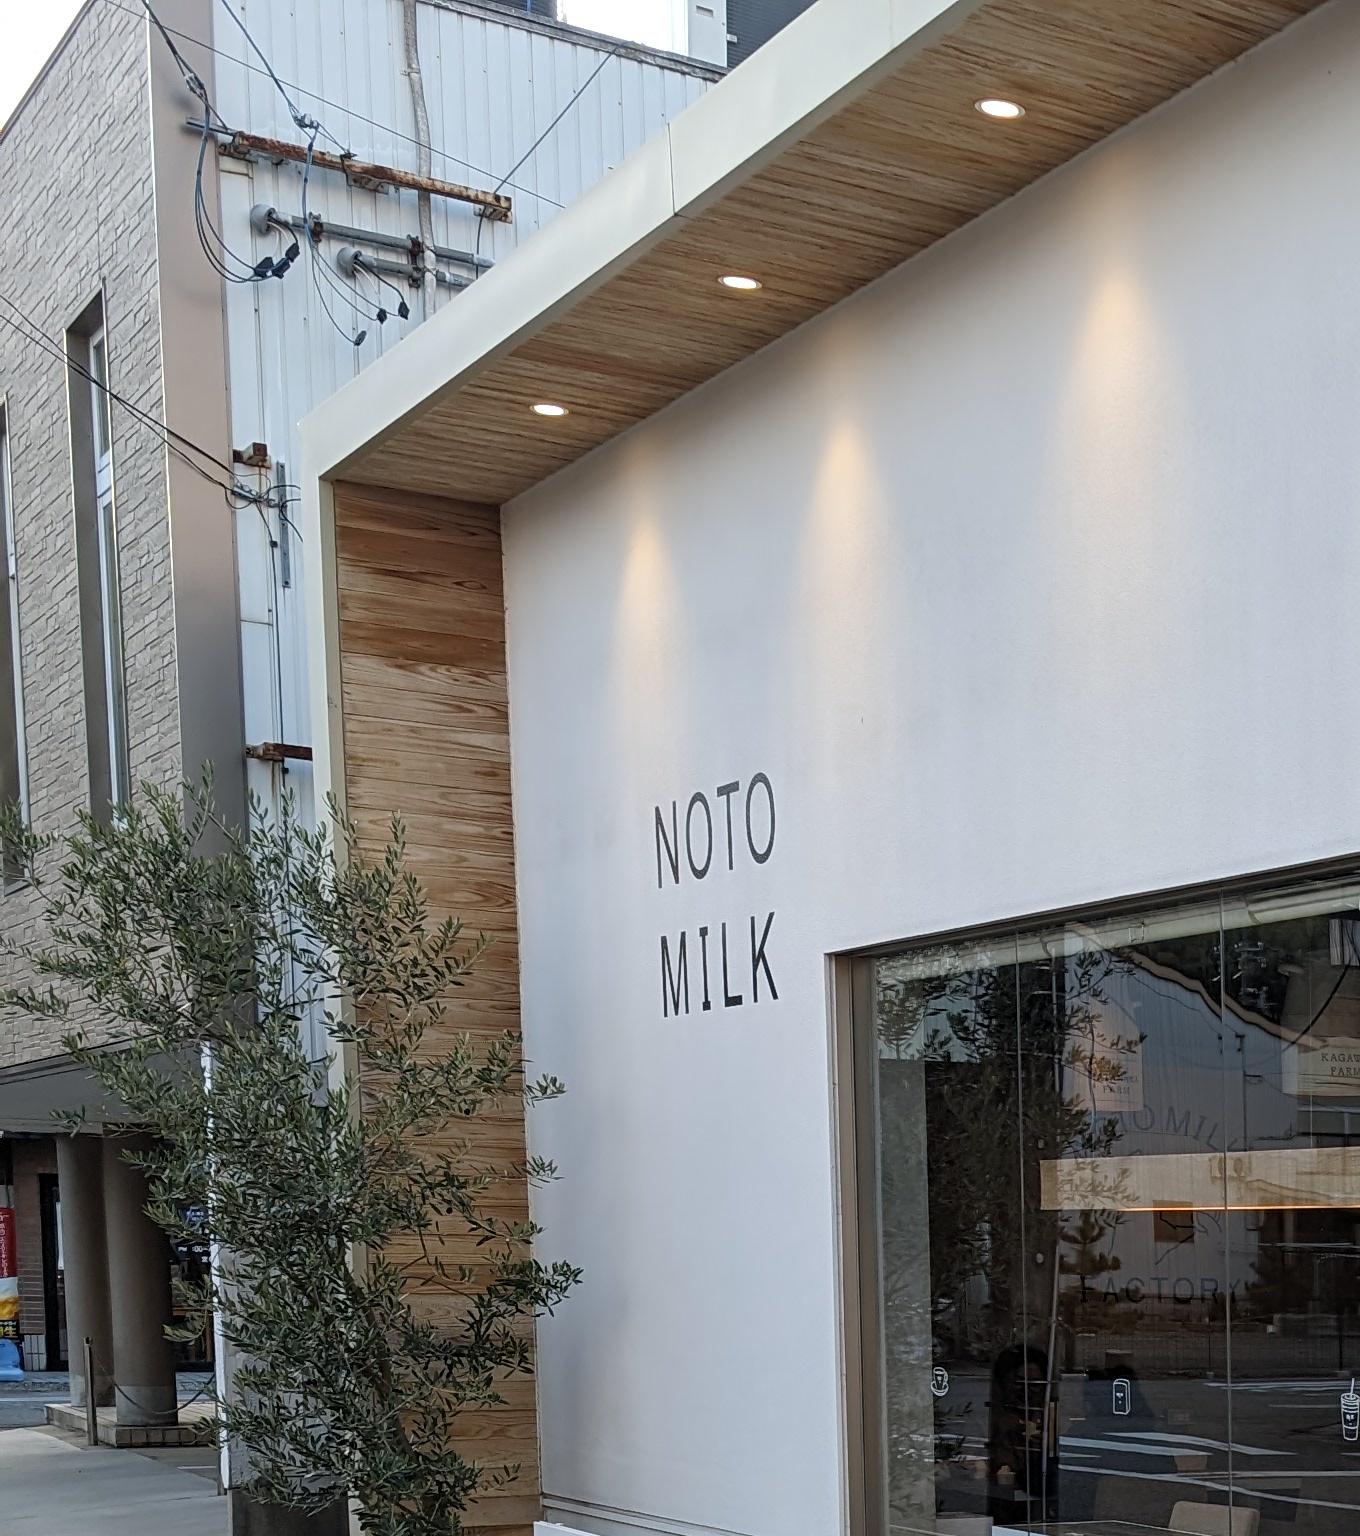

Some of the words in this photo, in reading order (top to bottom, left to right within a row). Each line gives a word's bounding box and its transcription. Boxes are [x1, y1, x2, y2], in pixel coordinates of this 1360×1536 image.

[654, 772, 776, 889] NOTO
[660, 911, 779, 1018] MILK
[1079, 1274, 1241, 1304] FACTORY
